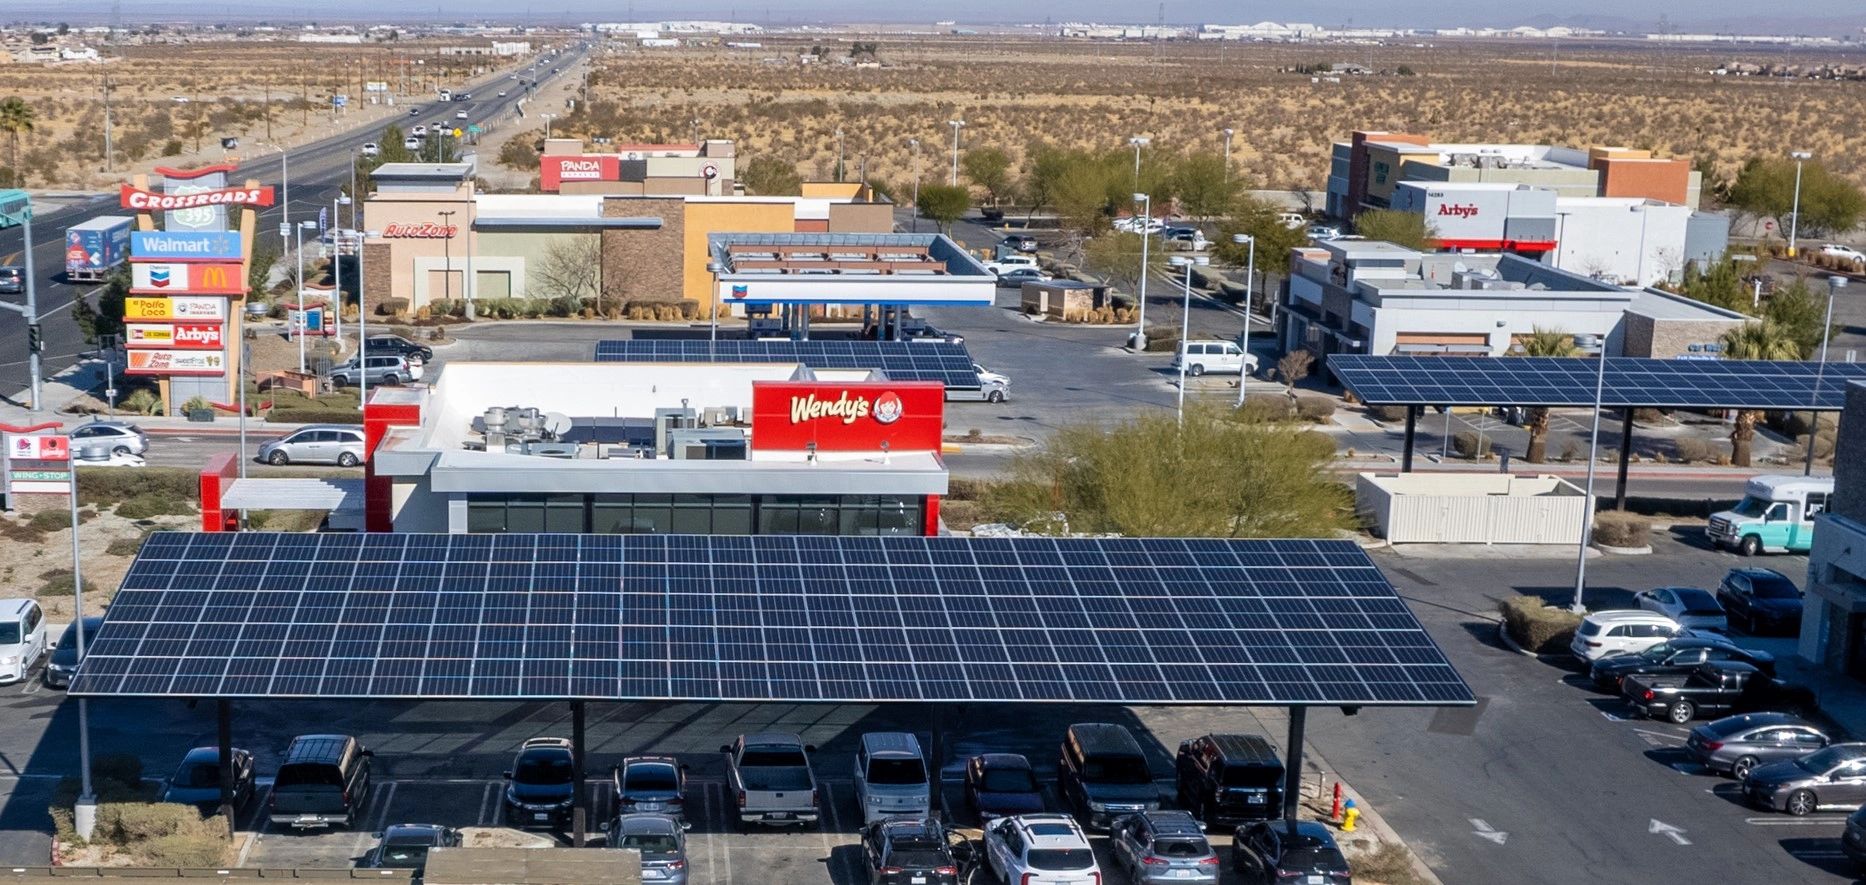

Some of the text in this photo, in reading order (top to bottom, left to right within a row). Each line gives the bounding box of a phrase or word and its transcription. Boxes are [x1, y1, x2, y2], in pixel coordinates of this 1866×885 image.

[560, 160, 600, 171] PANDA
[129, 189, 260, 208] CROSSROADS
[186, 208, 212, 222] 395
[1438, 203, 1479, 219] Arby's
[383, 222, 458, 239] AutoZone
[143, 237, 211, 253] Walmart
[140, 300, 166, 309] Pollo
[141, 309, 166, 317] Loco
[175, 326, 220, 344] Arby's
[150, 360, 171, 368] Zone
[152, 352, 173, 361] Auto
[791, 391, 869, 425] Wendy's
